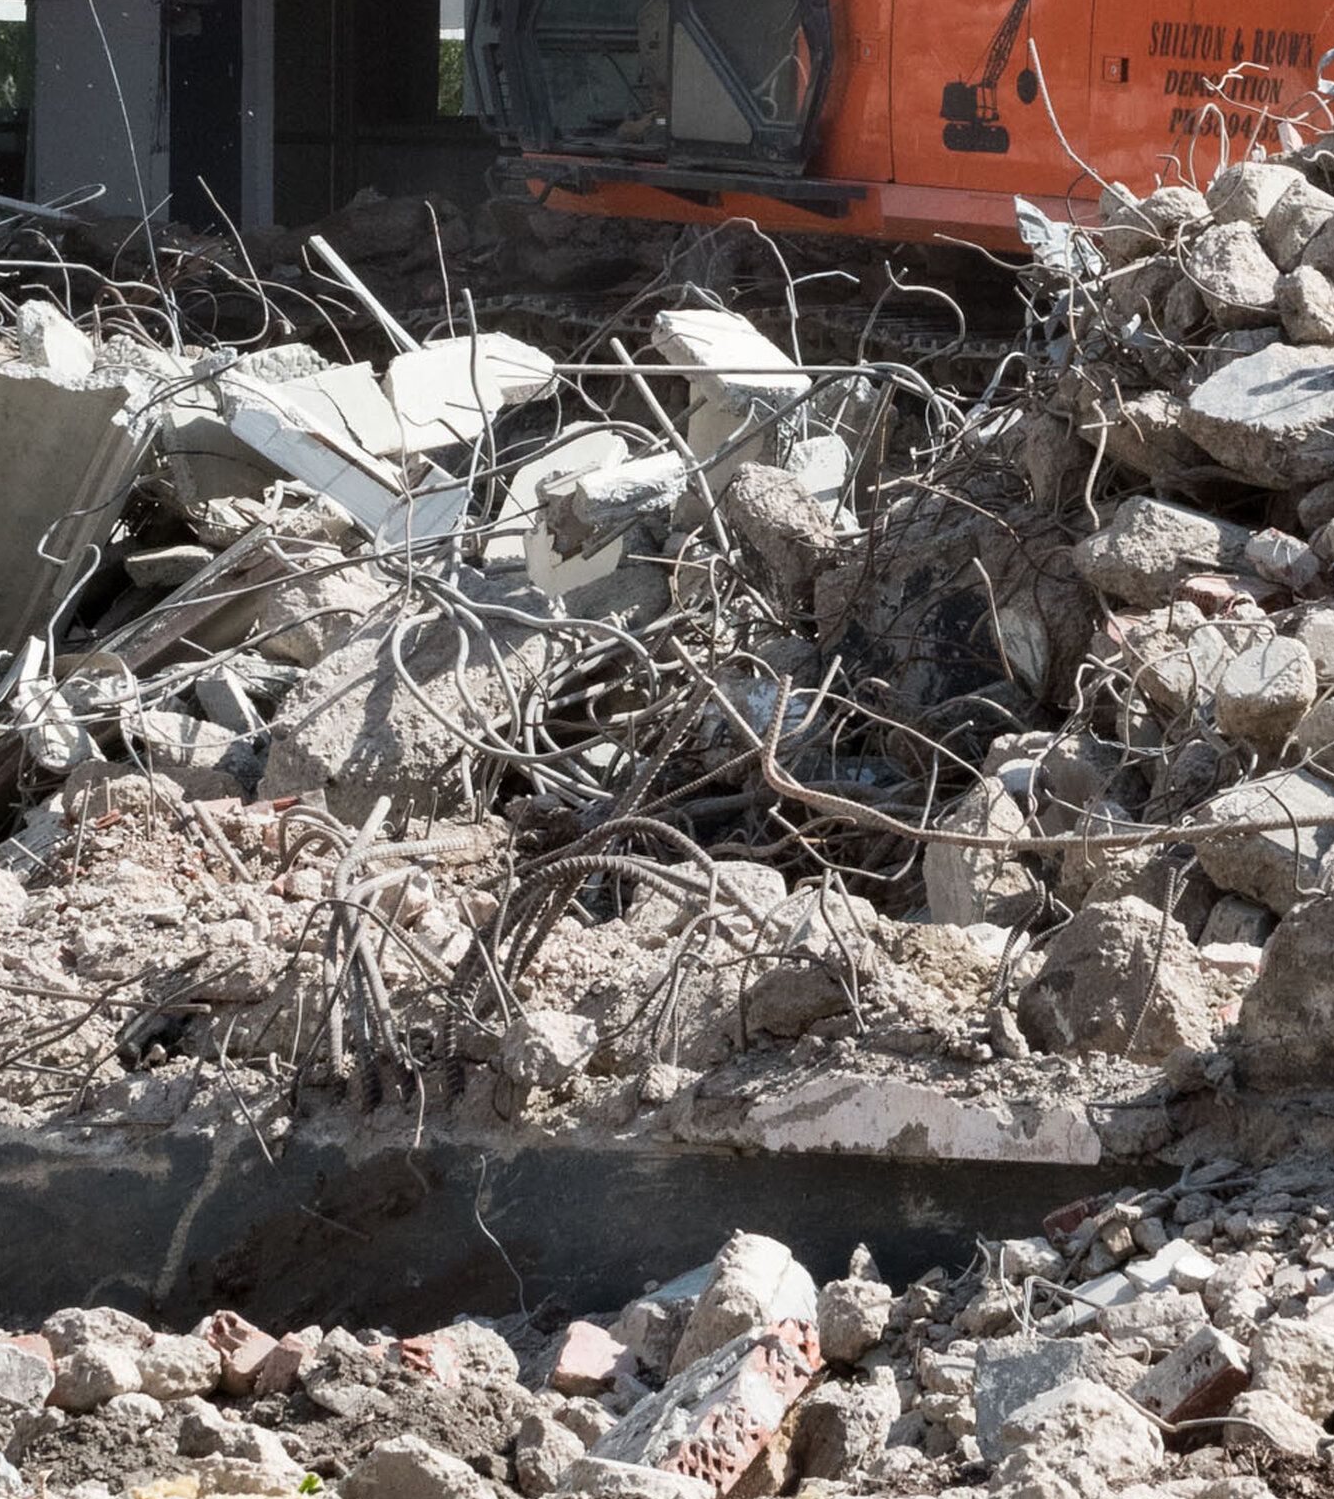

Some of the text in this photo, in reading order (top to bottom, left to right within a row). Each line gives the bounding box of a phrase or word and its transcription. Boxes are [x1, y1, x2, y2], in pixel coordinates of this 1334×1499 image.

[1149, 22, 1317, 69] SHILTON & BROWN
